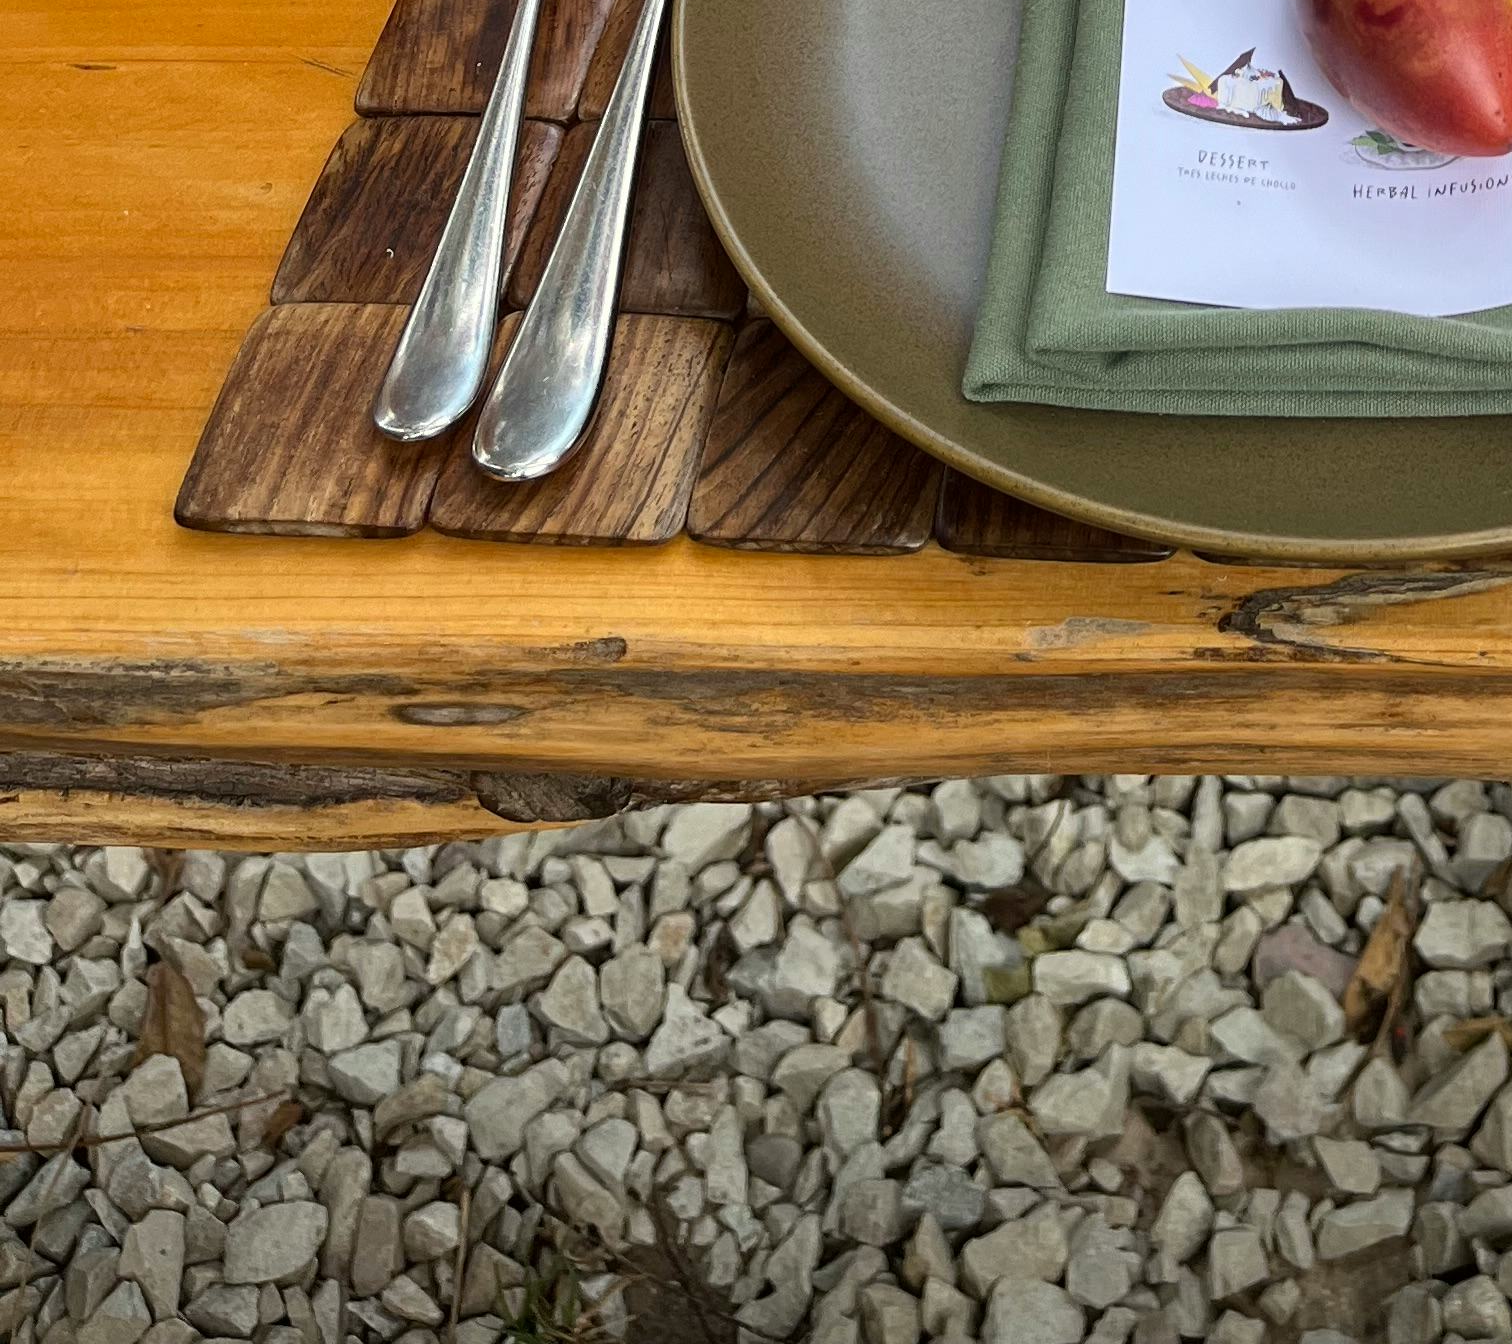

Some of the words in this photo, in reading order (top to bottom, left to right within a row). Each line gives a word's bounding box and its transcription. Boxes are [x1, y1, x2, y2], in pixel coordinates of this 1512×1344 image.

[1198, 149, 1270, 170] DESSERT
[1205, 170, 1239, 184] LECHES
[1353, 183, 1418, 200] HERBAL
